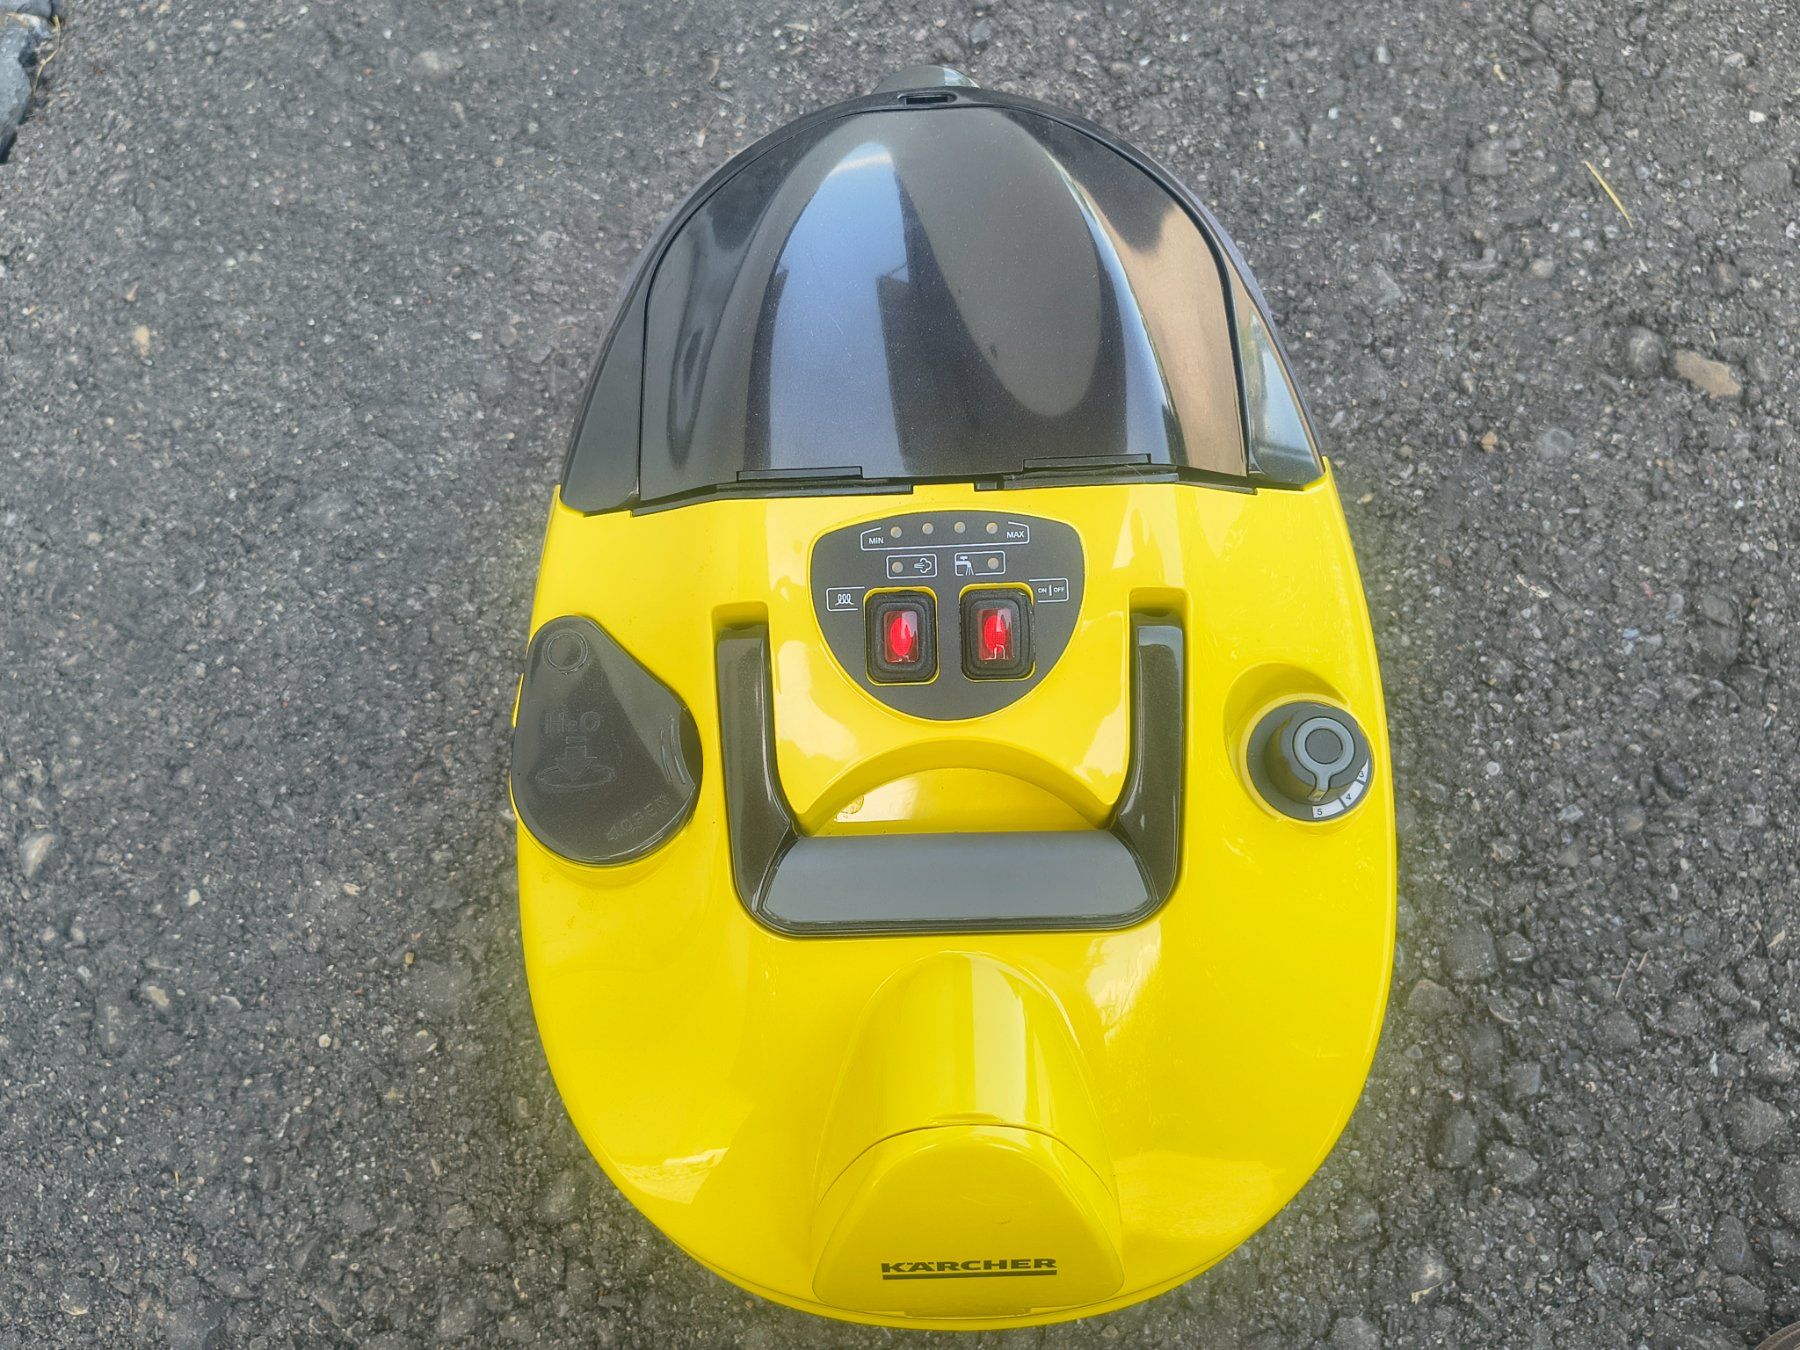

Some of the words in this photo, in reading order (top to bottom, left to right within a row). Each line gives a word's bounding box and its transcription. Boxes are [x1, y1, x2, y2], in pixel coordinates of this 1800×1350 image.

[1006, 531, 1025, 539] MAX
[868, 537, 884, 545] MIN
[1317, 808, 1323, 816] 5
[881, 1258, 1057, 1273] KÄRCHER
